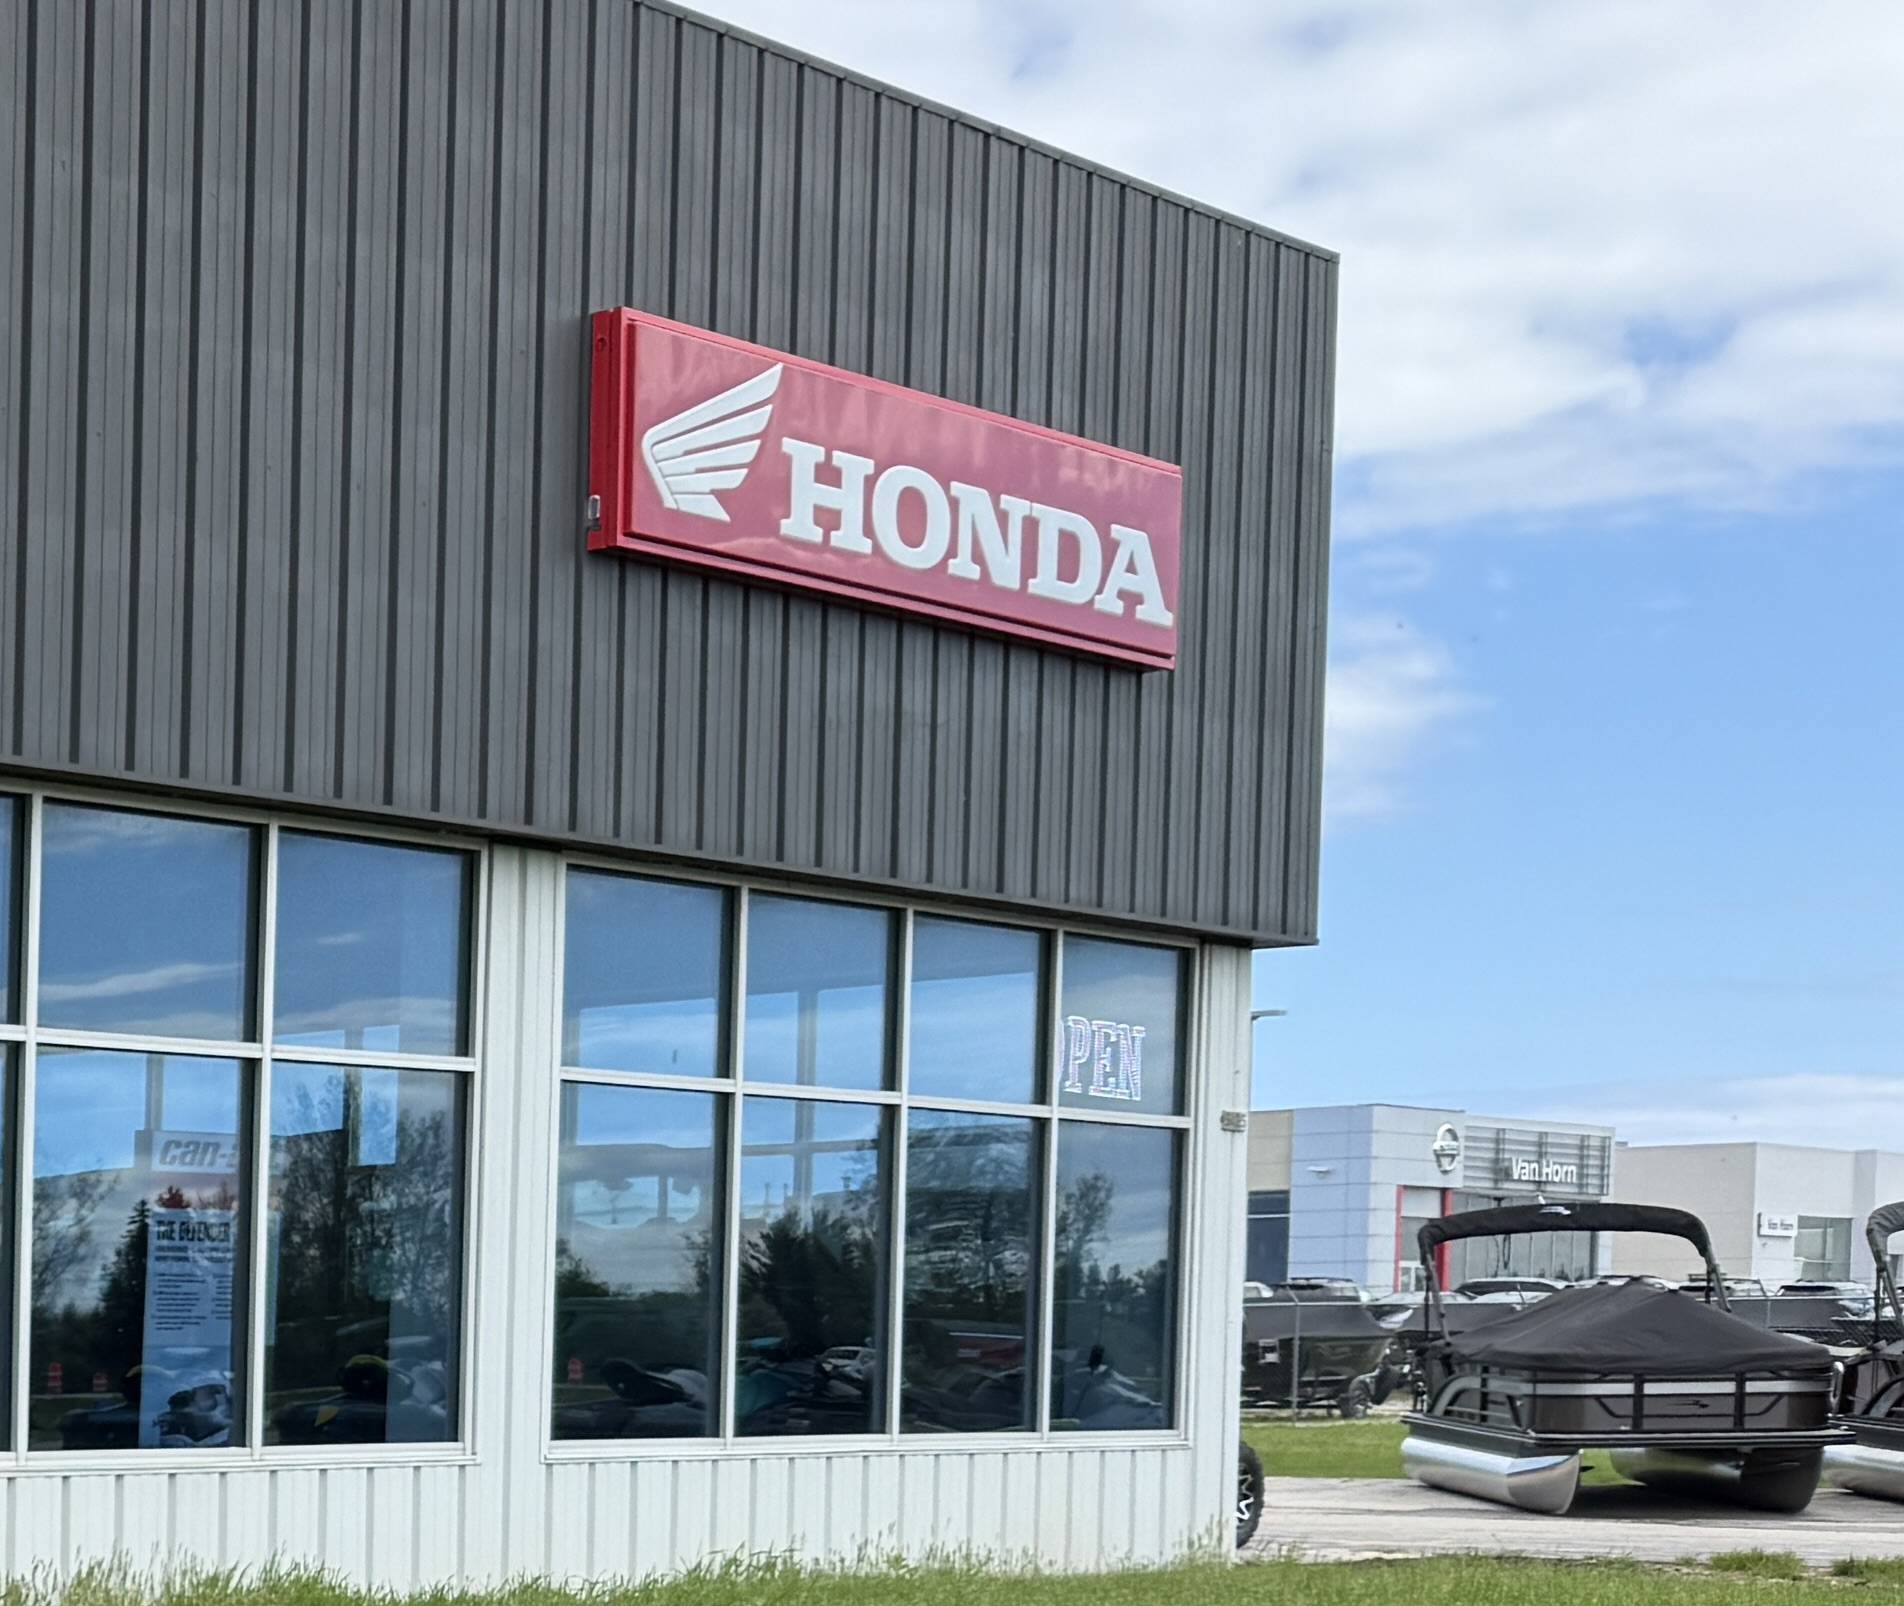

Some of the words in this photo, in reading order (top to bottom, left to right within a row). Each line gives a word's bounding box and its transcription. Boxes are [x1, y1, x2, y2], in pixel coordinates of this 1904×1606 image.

[779, 436, 1174, 627] HONDA
[1058, 1015, 1146, 1101] PEN
[1511, 1157, 1539, 1182] Van
[1542, 1159, 1577, 1184] Horn
